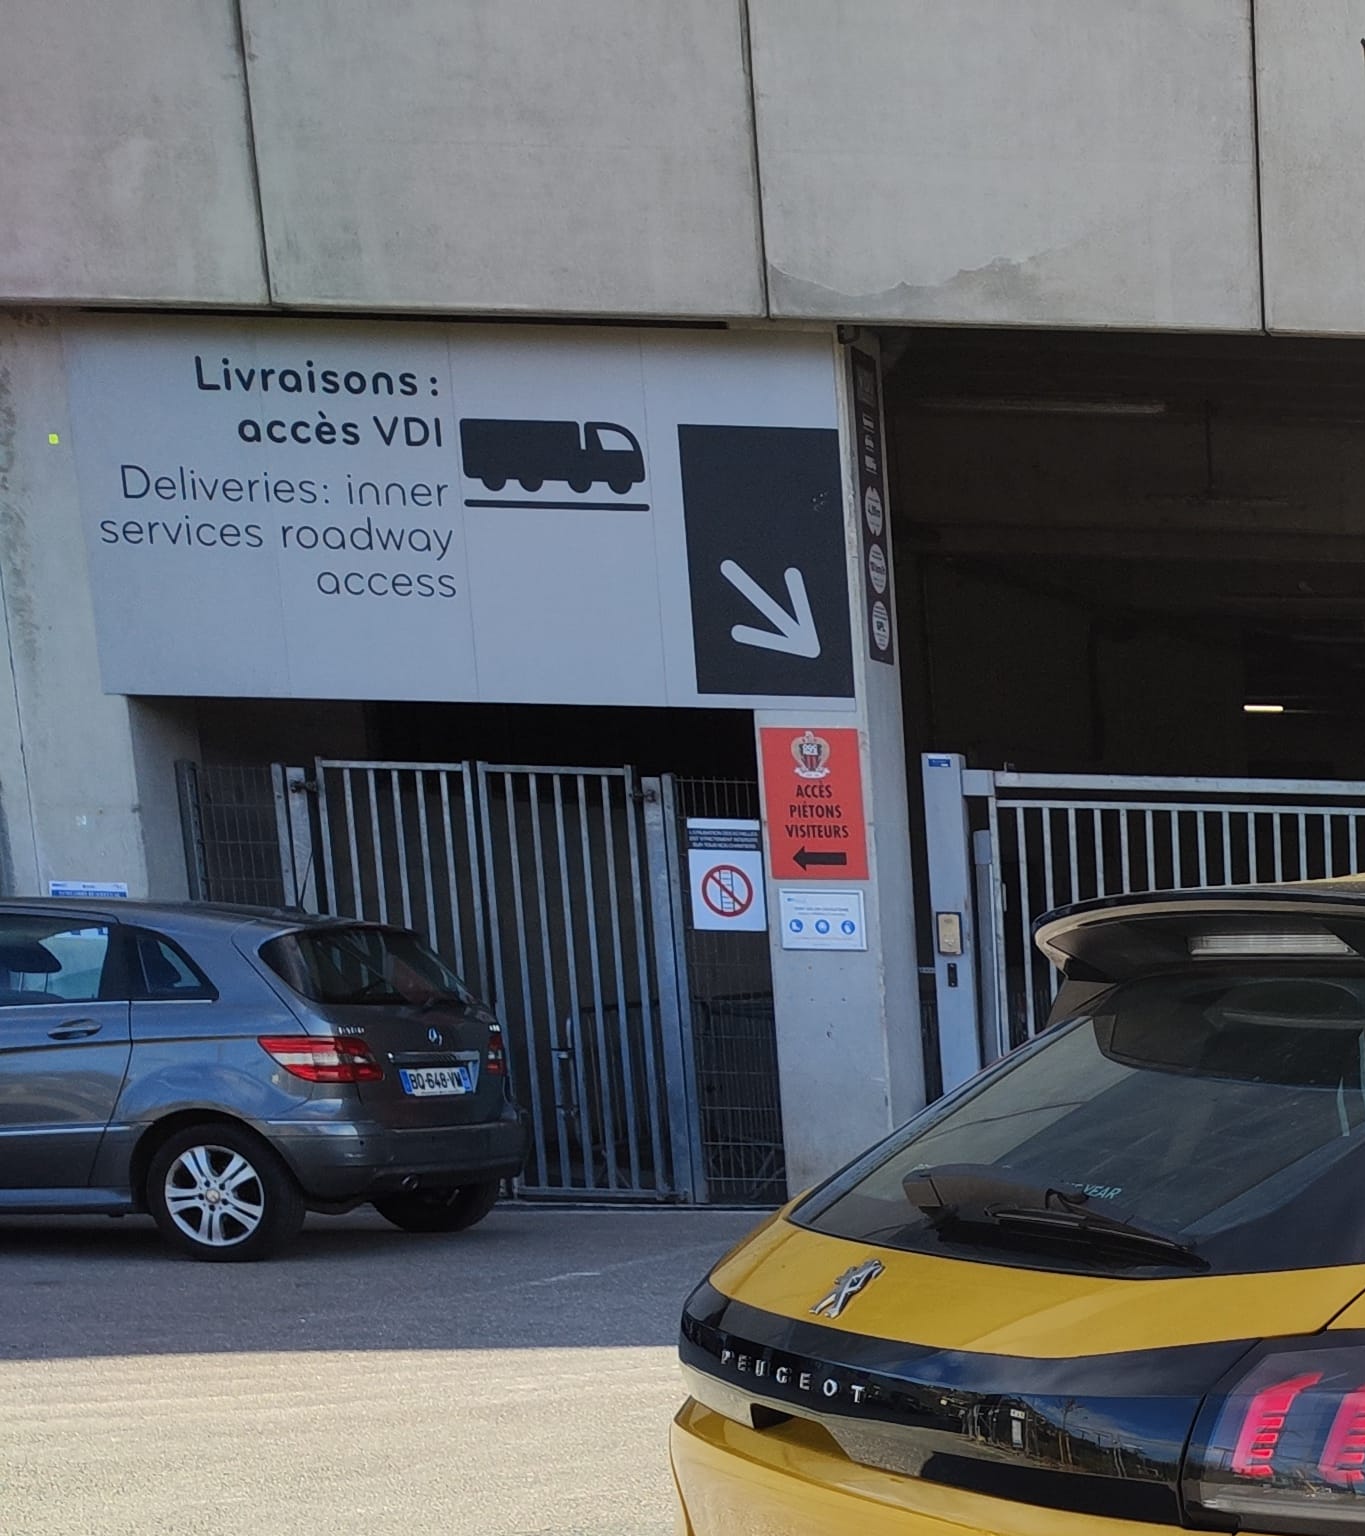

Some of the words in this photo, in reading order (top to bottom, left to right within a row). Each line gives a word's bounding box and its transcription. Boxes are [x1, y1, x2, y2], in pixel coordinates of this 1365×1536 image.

[194, 355, 418, 396] Livraisons
[237, 410, 361, 446] accès
[372, 415, 442, 448] VDI
[120, 463, 330, 504] Deliveries:
[346, 473, 450, 508] inner
[99, 514, 264, 548] services
[280, 516, 454, 561] roadway
[316, 570, 458, 598] access
[788, 800, 843, 819] PIÉTONS
[784, 823, 850, 839] VISITEURS
[720, 1350, 866, 1405] PEUGEOT
